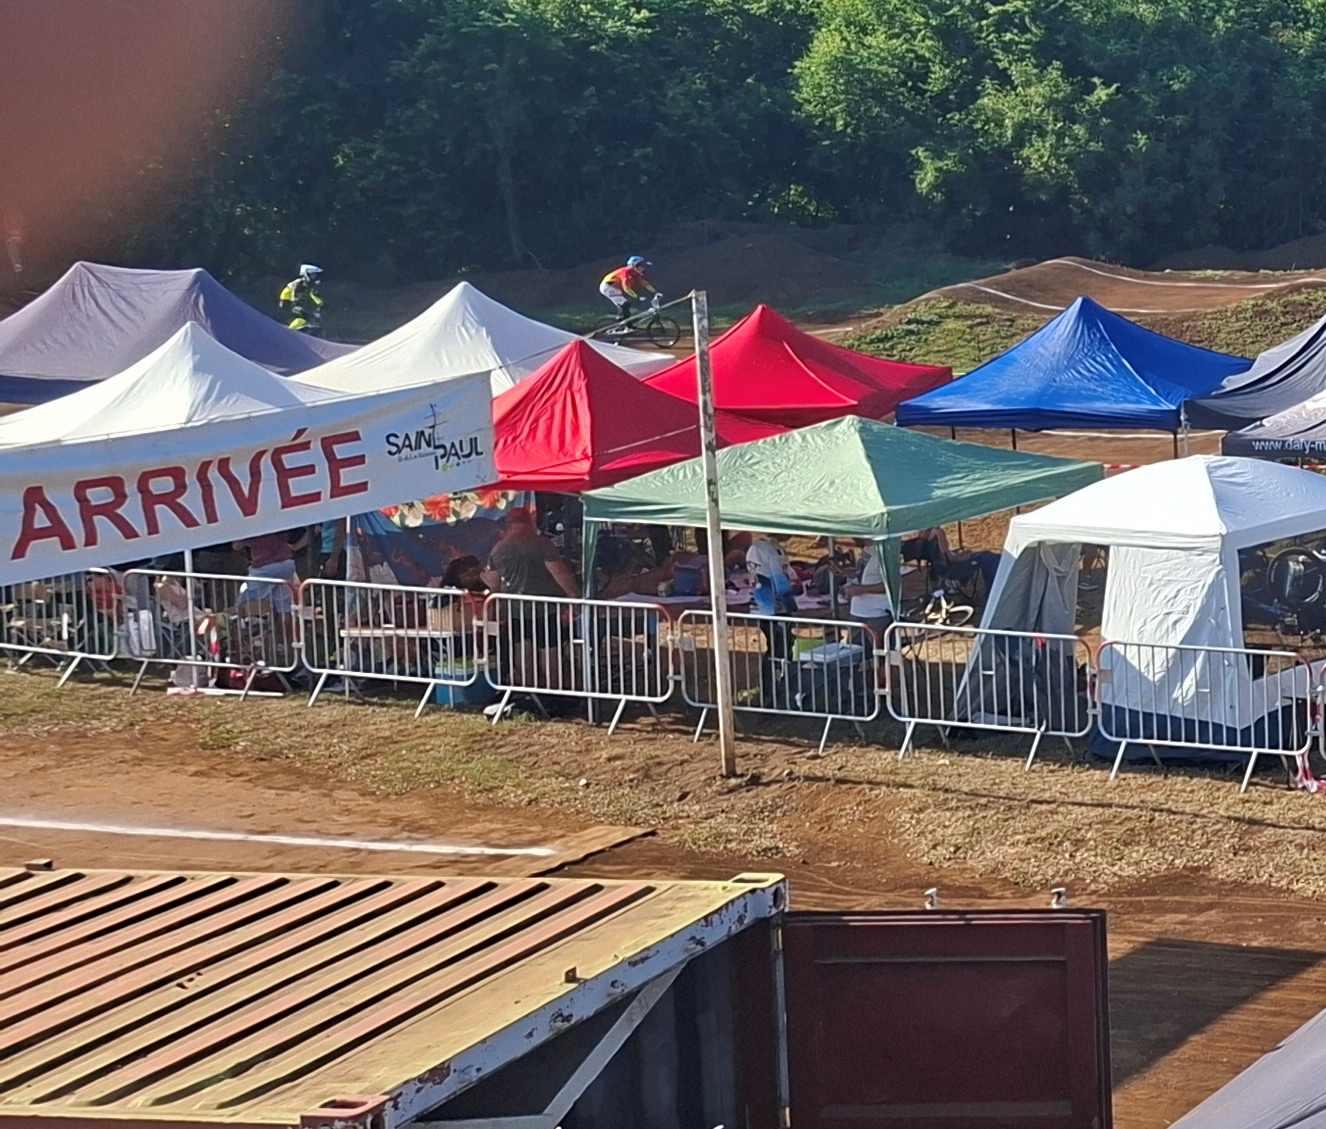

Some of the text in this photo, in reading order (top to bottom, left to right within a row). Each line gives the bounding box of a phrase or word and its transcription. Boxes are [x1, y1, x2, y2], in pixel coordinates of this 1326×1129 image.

[385, 418, 441, 457] SAINT
[432, 436, 484, 470] PAUL
[11, 427, 370, 561] ARRIVÉE
